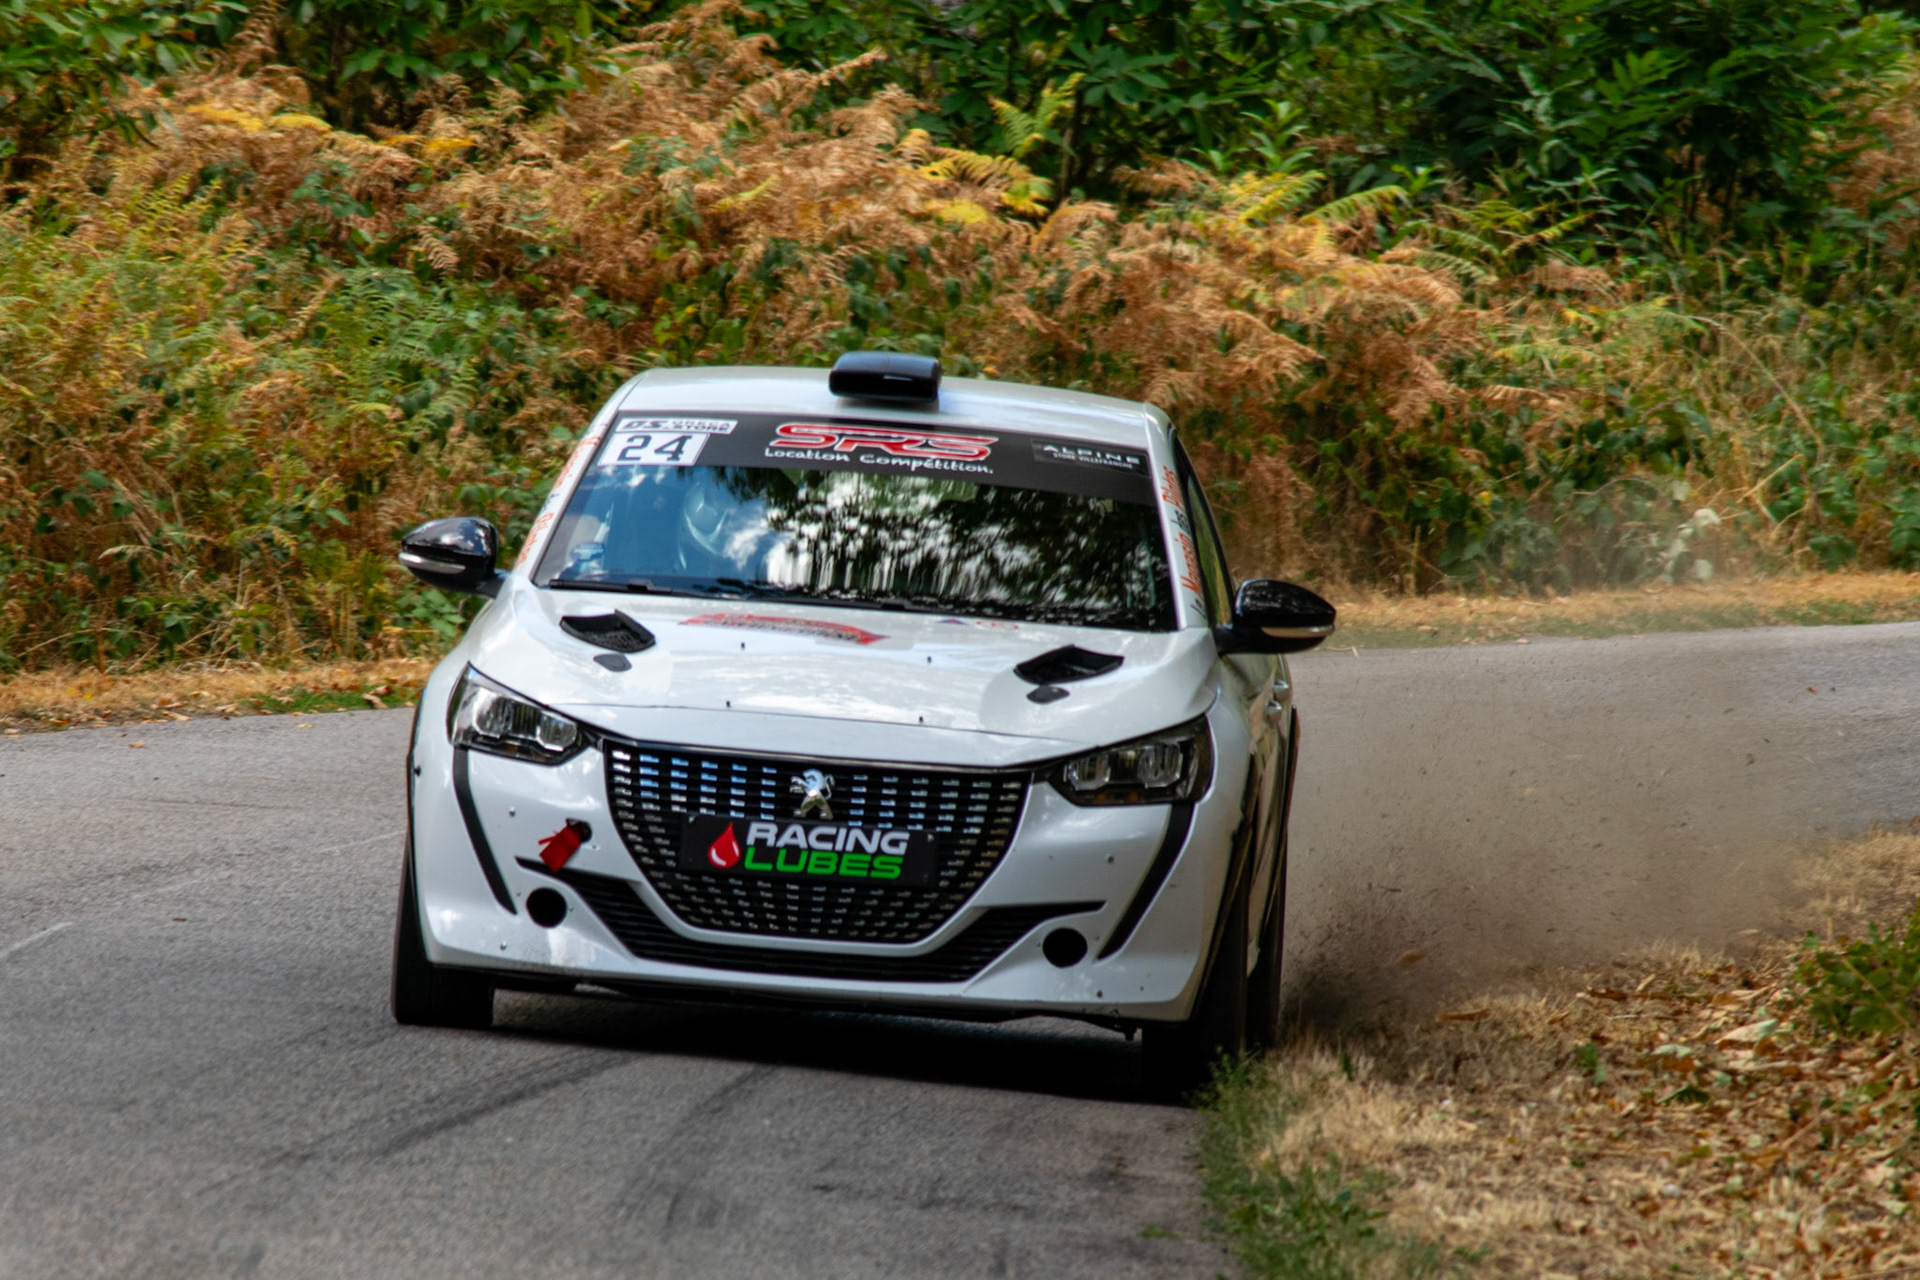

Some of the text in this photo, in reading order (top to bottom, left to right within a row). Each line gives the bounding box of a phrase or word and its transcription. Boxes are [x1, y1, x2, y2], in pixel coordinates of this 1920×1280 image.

[617, 435, 693, 462] 24
[764, 447, 850, 463] Location
[769, 421, 999, 462] SRS
[1043, 444, 1140, 464] ALPINE
[1053, 452, 1133, 470] STORE VILLEFRANCHE
[746, 821, 910, 856] RACING
[744, 845, 904, 880] LUBES
